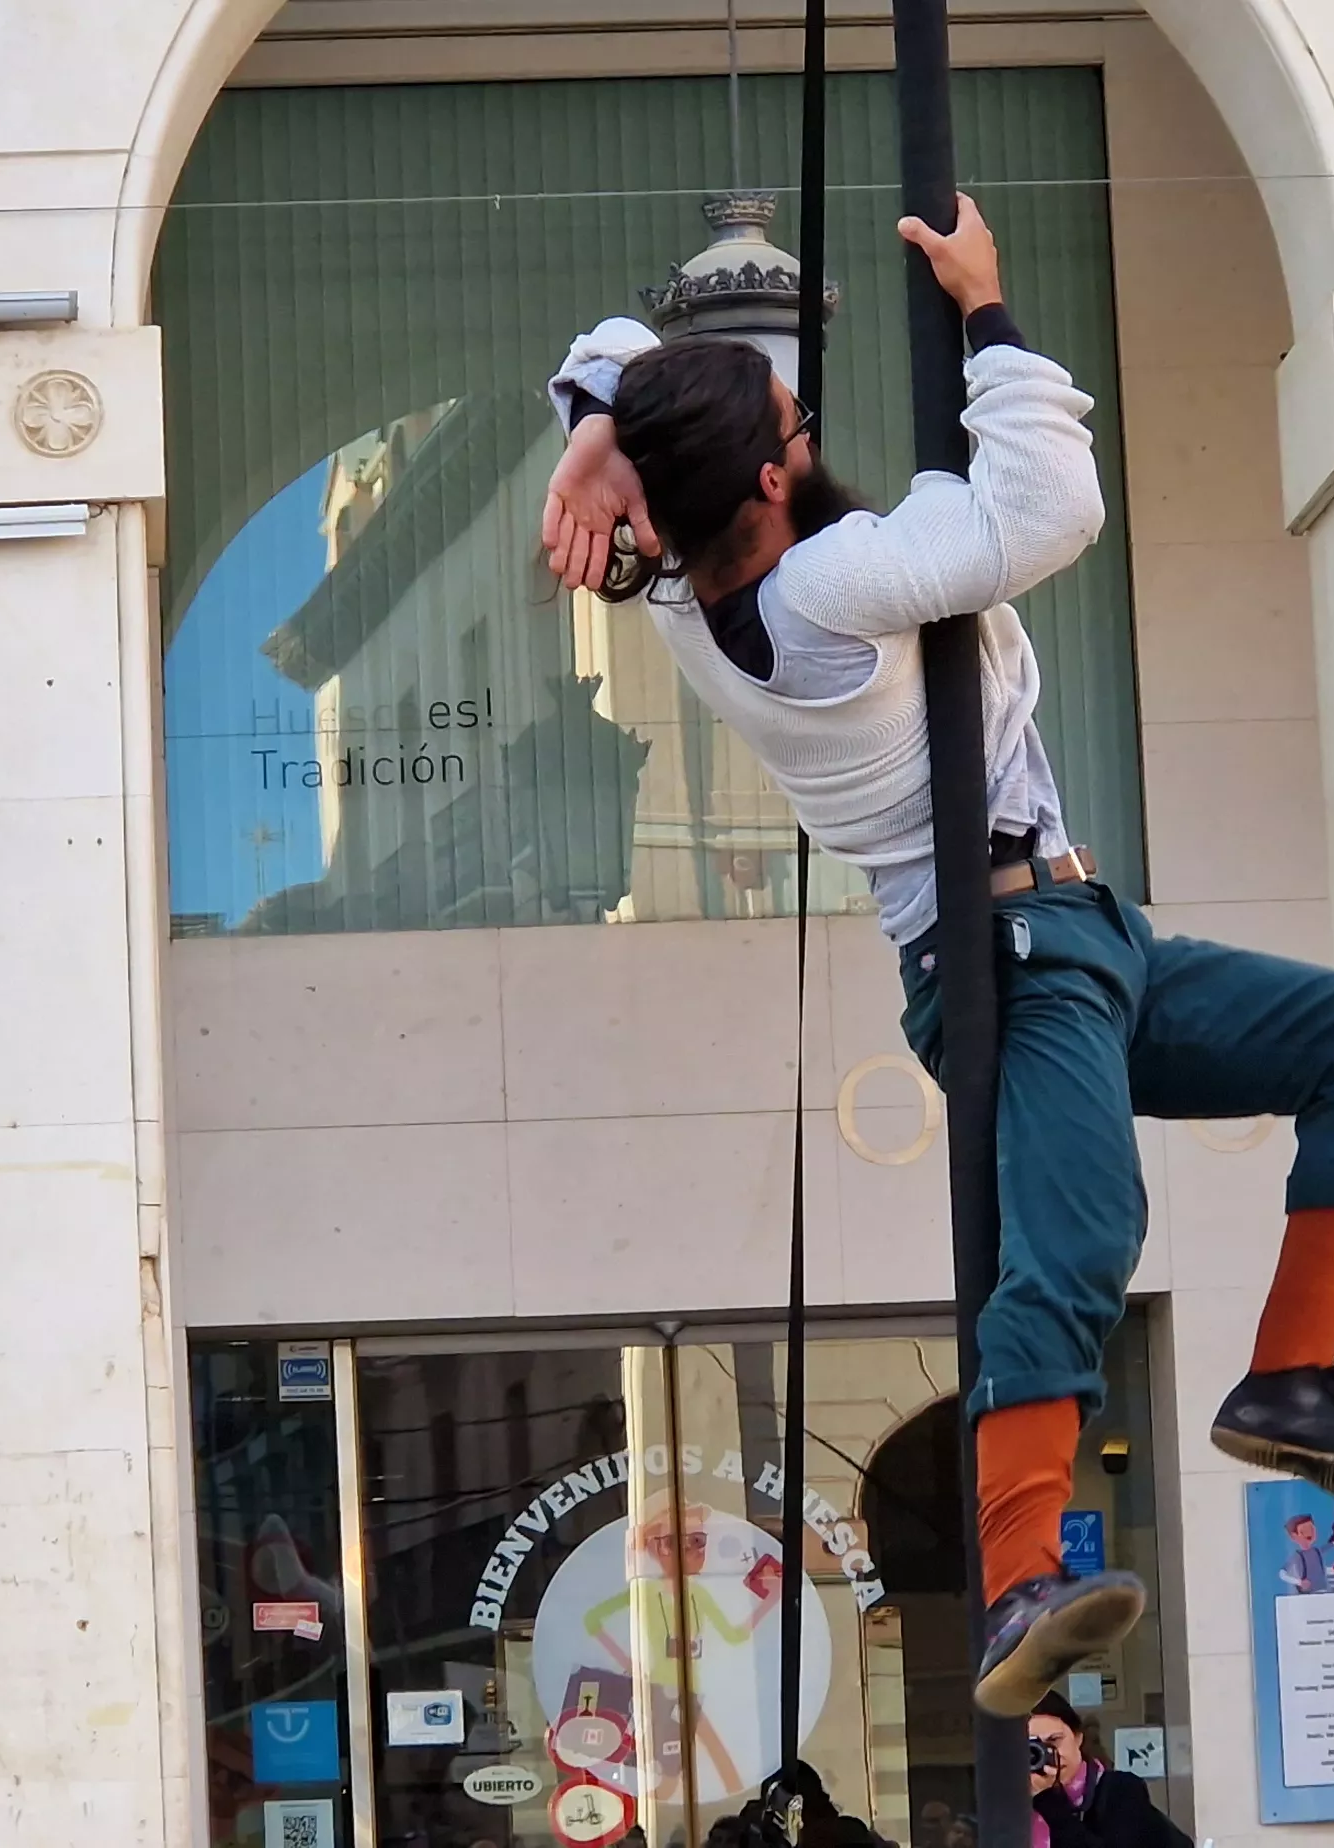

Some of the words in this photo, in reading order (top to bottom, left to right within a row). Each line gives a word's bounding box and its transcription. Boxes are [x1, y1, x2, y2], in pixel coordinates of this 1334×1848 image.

[428, 688, 494, 729] es!
[251, 742, 465, 790] Tradición
[712, 1447, 746, 1483] A
[473, 1780, 535, 1793] UBIERTO
